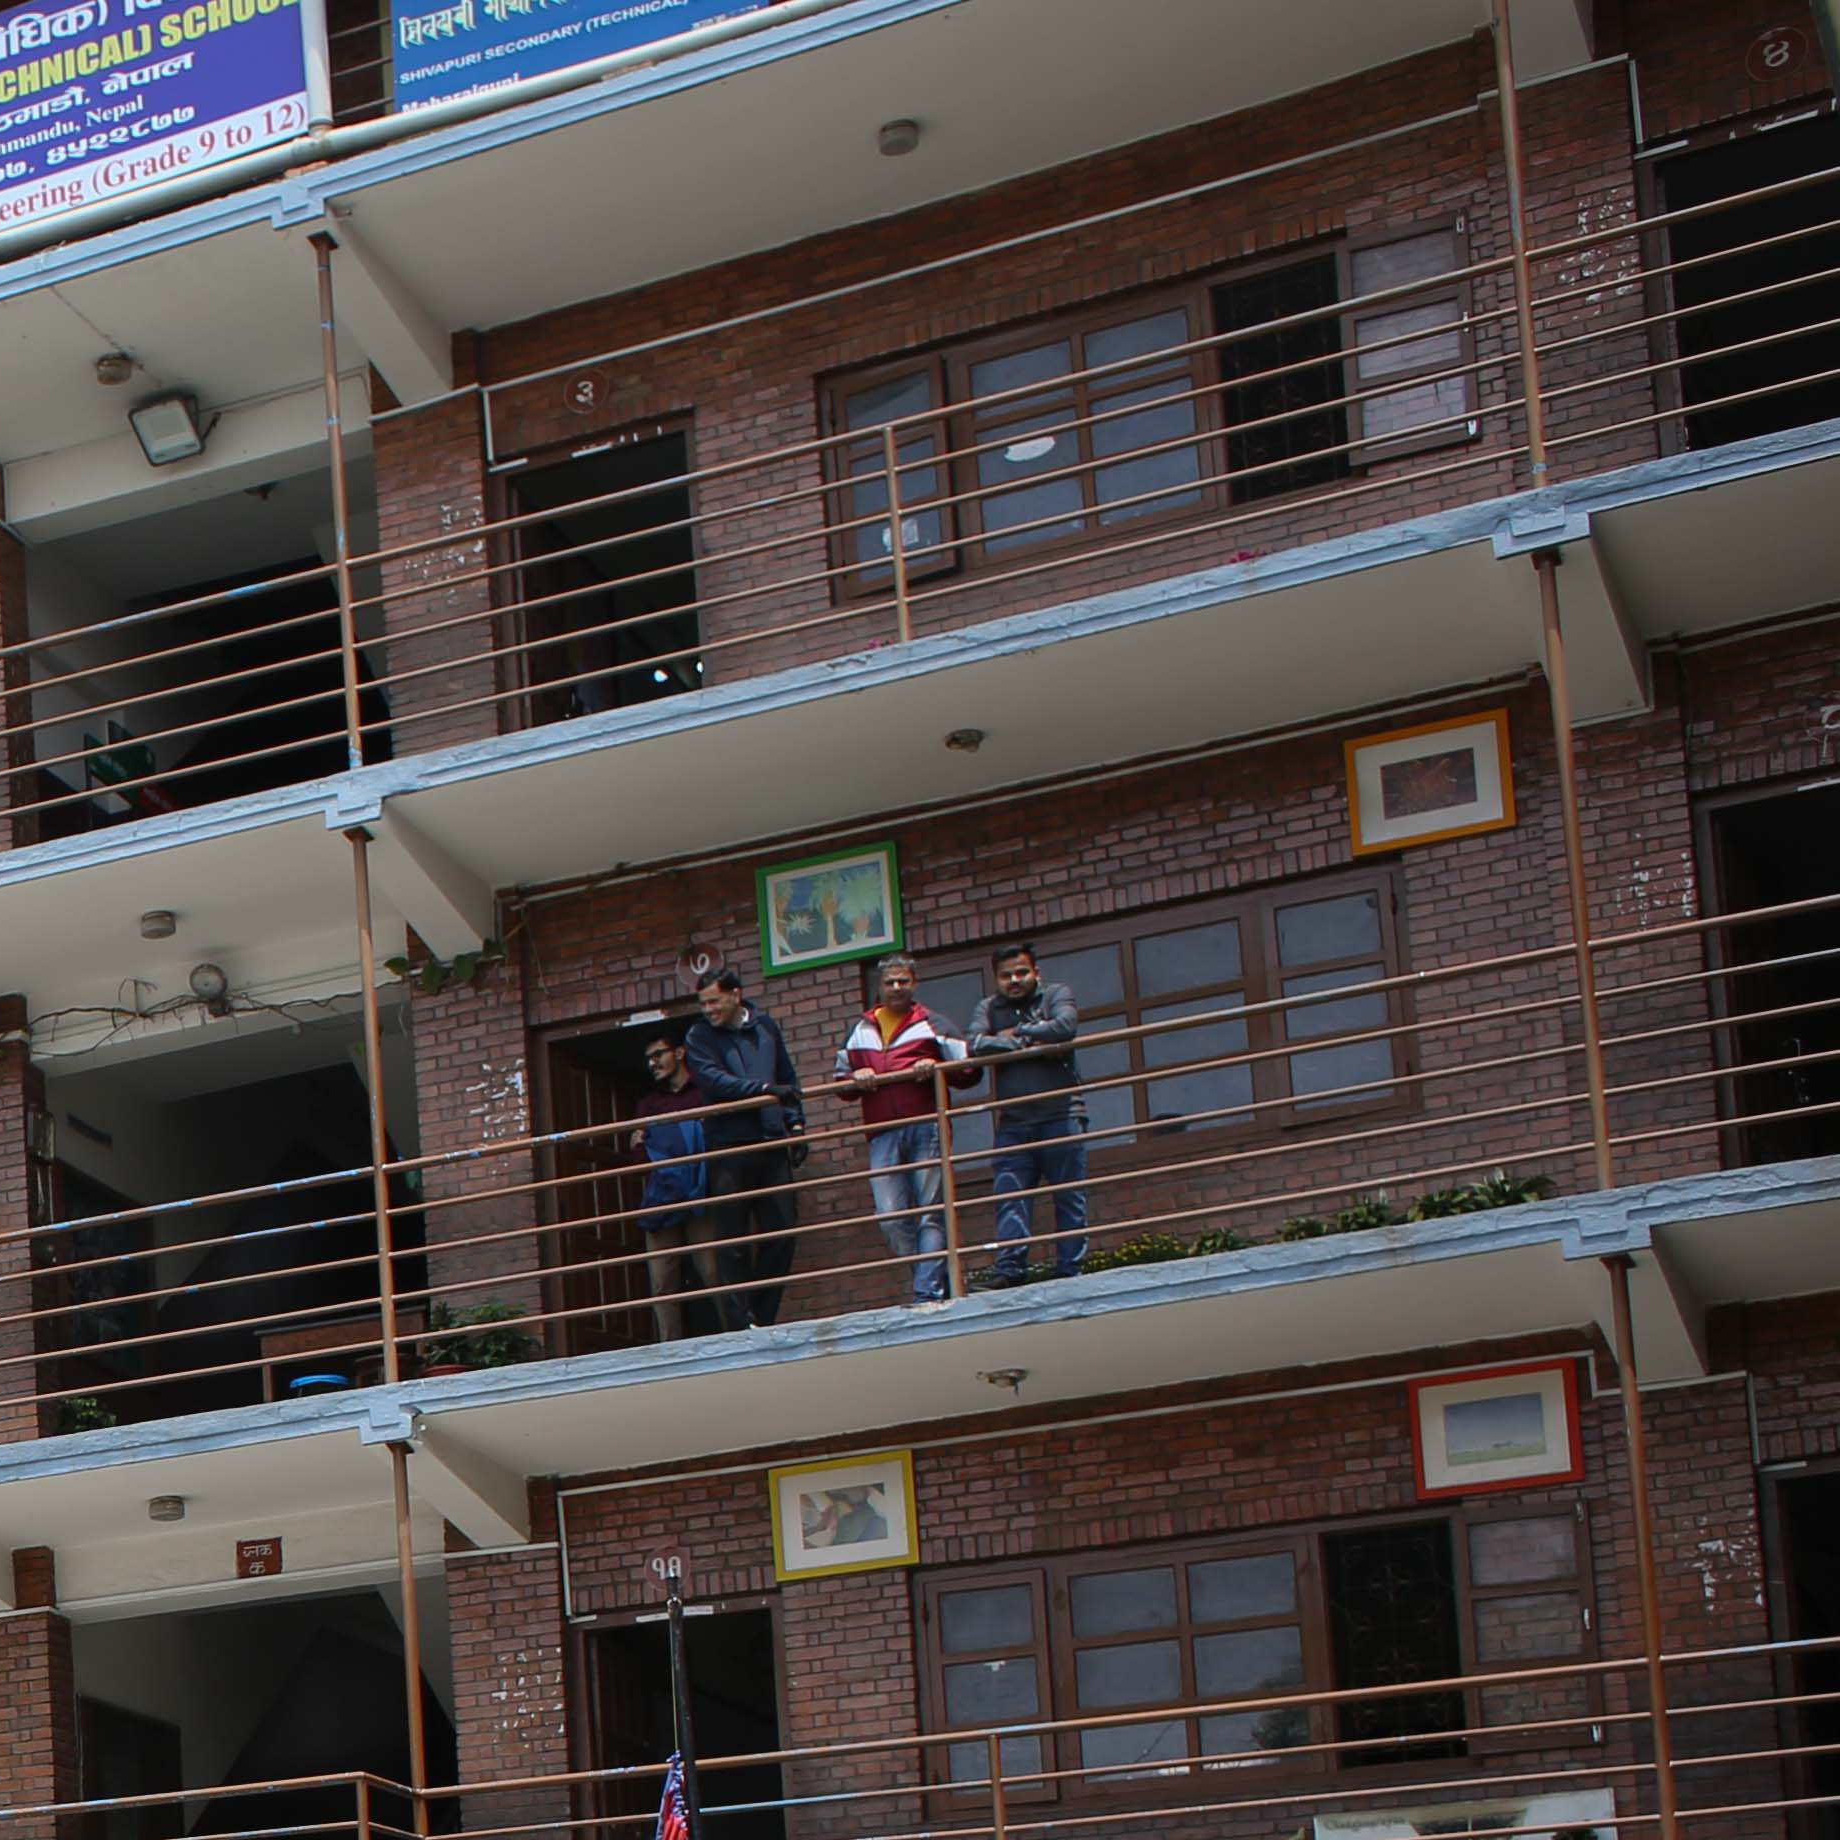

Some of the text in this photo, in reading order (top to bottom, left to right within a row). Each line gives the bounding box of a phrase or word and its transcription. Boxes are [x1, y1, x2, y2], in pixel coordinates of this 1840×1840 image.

[160, 0, 301, 48] SCHO
[102, 51, 195, 95] नेपाल
[400, 52, 481, 84] SHIVAPURI
[484, 22, 583, 60] SECONDARY
[46, 105, 195, 165] ४५२२८७७
[85, 95, 144, 127] Nepal
[91, 142, 190, 195] (Grade
[199, 131, 215, 156] 9
[226, 122, 252, 149] to
[263, 102, 305, 137] 12)
[249, 1561, 265, 1575] क
